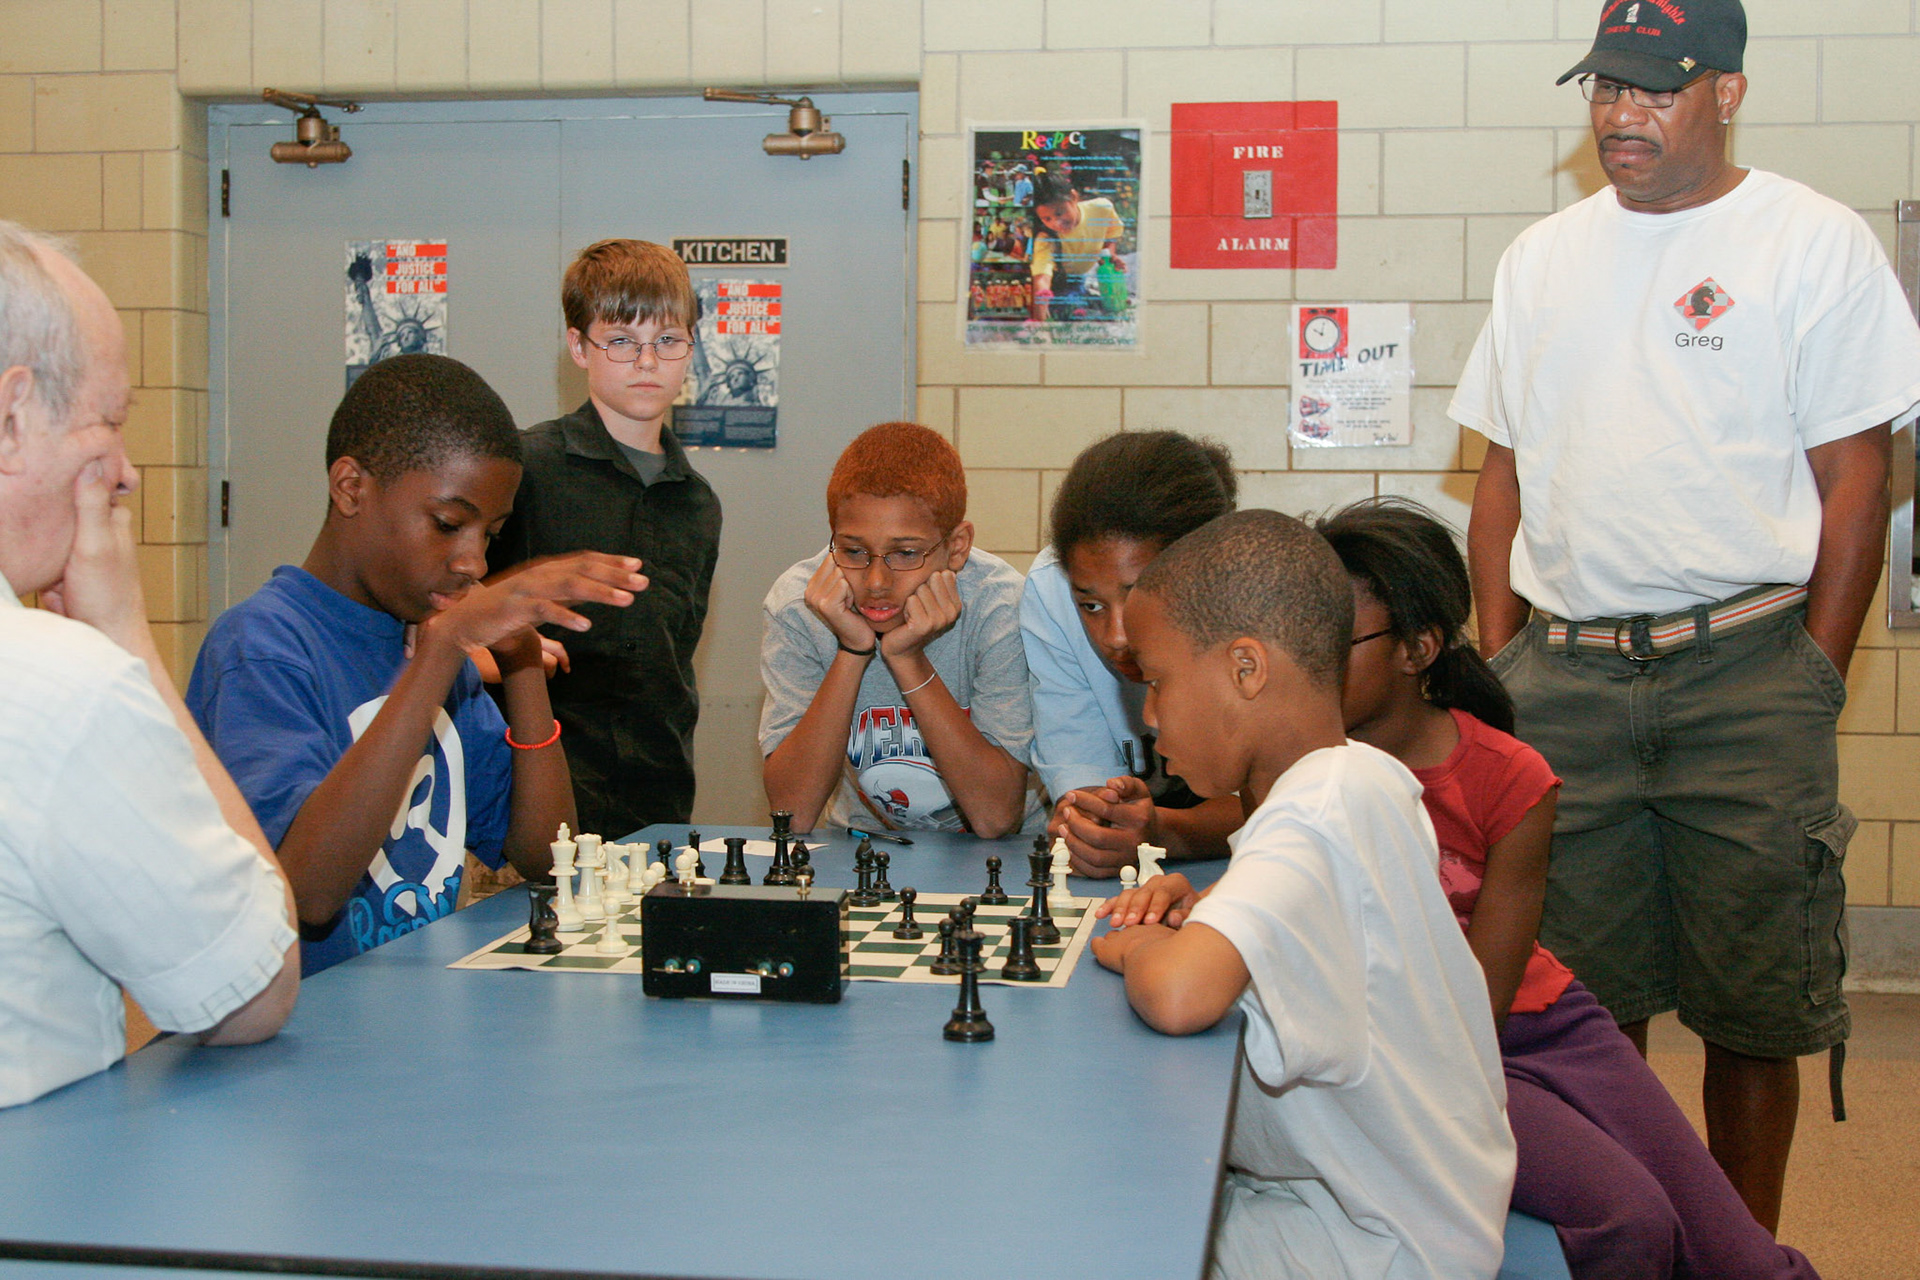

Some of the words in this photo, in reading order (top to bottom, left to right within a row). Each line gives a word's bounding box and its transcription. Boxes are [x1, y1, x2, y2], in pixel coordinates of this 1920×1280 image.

[1020, 130, 1087, 150] Respect
[1233, 145, 1284, 159] FIRE
[1217, 237, 1290, 251] ALARM
[682, 242, 775, 262] KITCHEN
[395, 262, 434, 275] JUSTICE
[396, 281, 415, 293] FOR
[727, 303, 768, 315] JUSTICE
[727, 321, 746, 334] FOR
[1675, 332, 1723, 351] Greg
[1300, 355, 1345, 377] TIME
[1358, 343, 1399, 364] OUT
